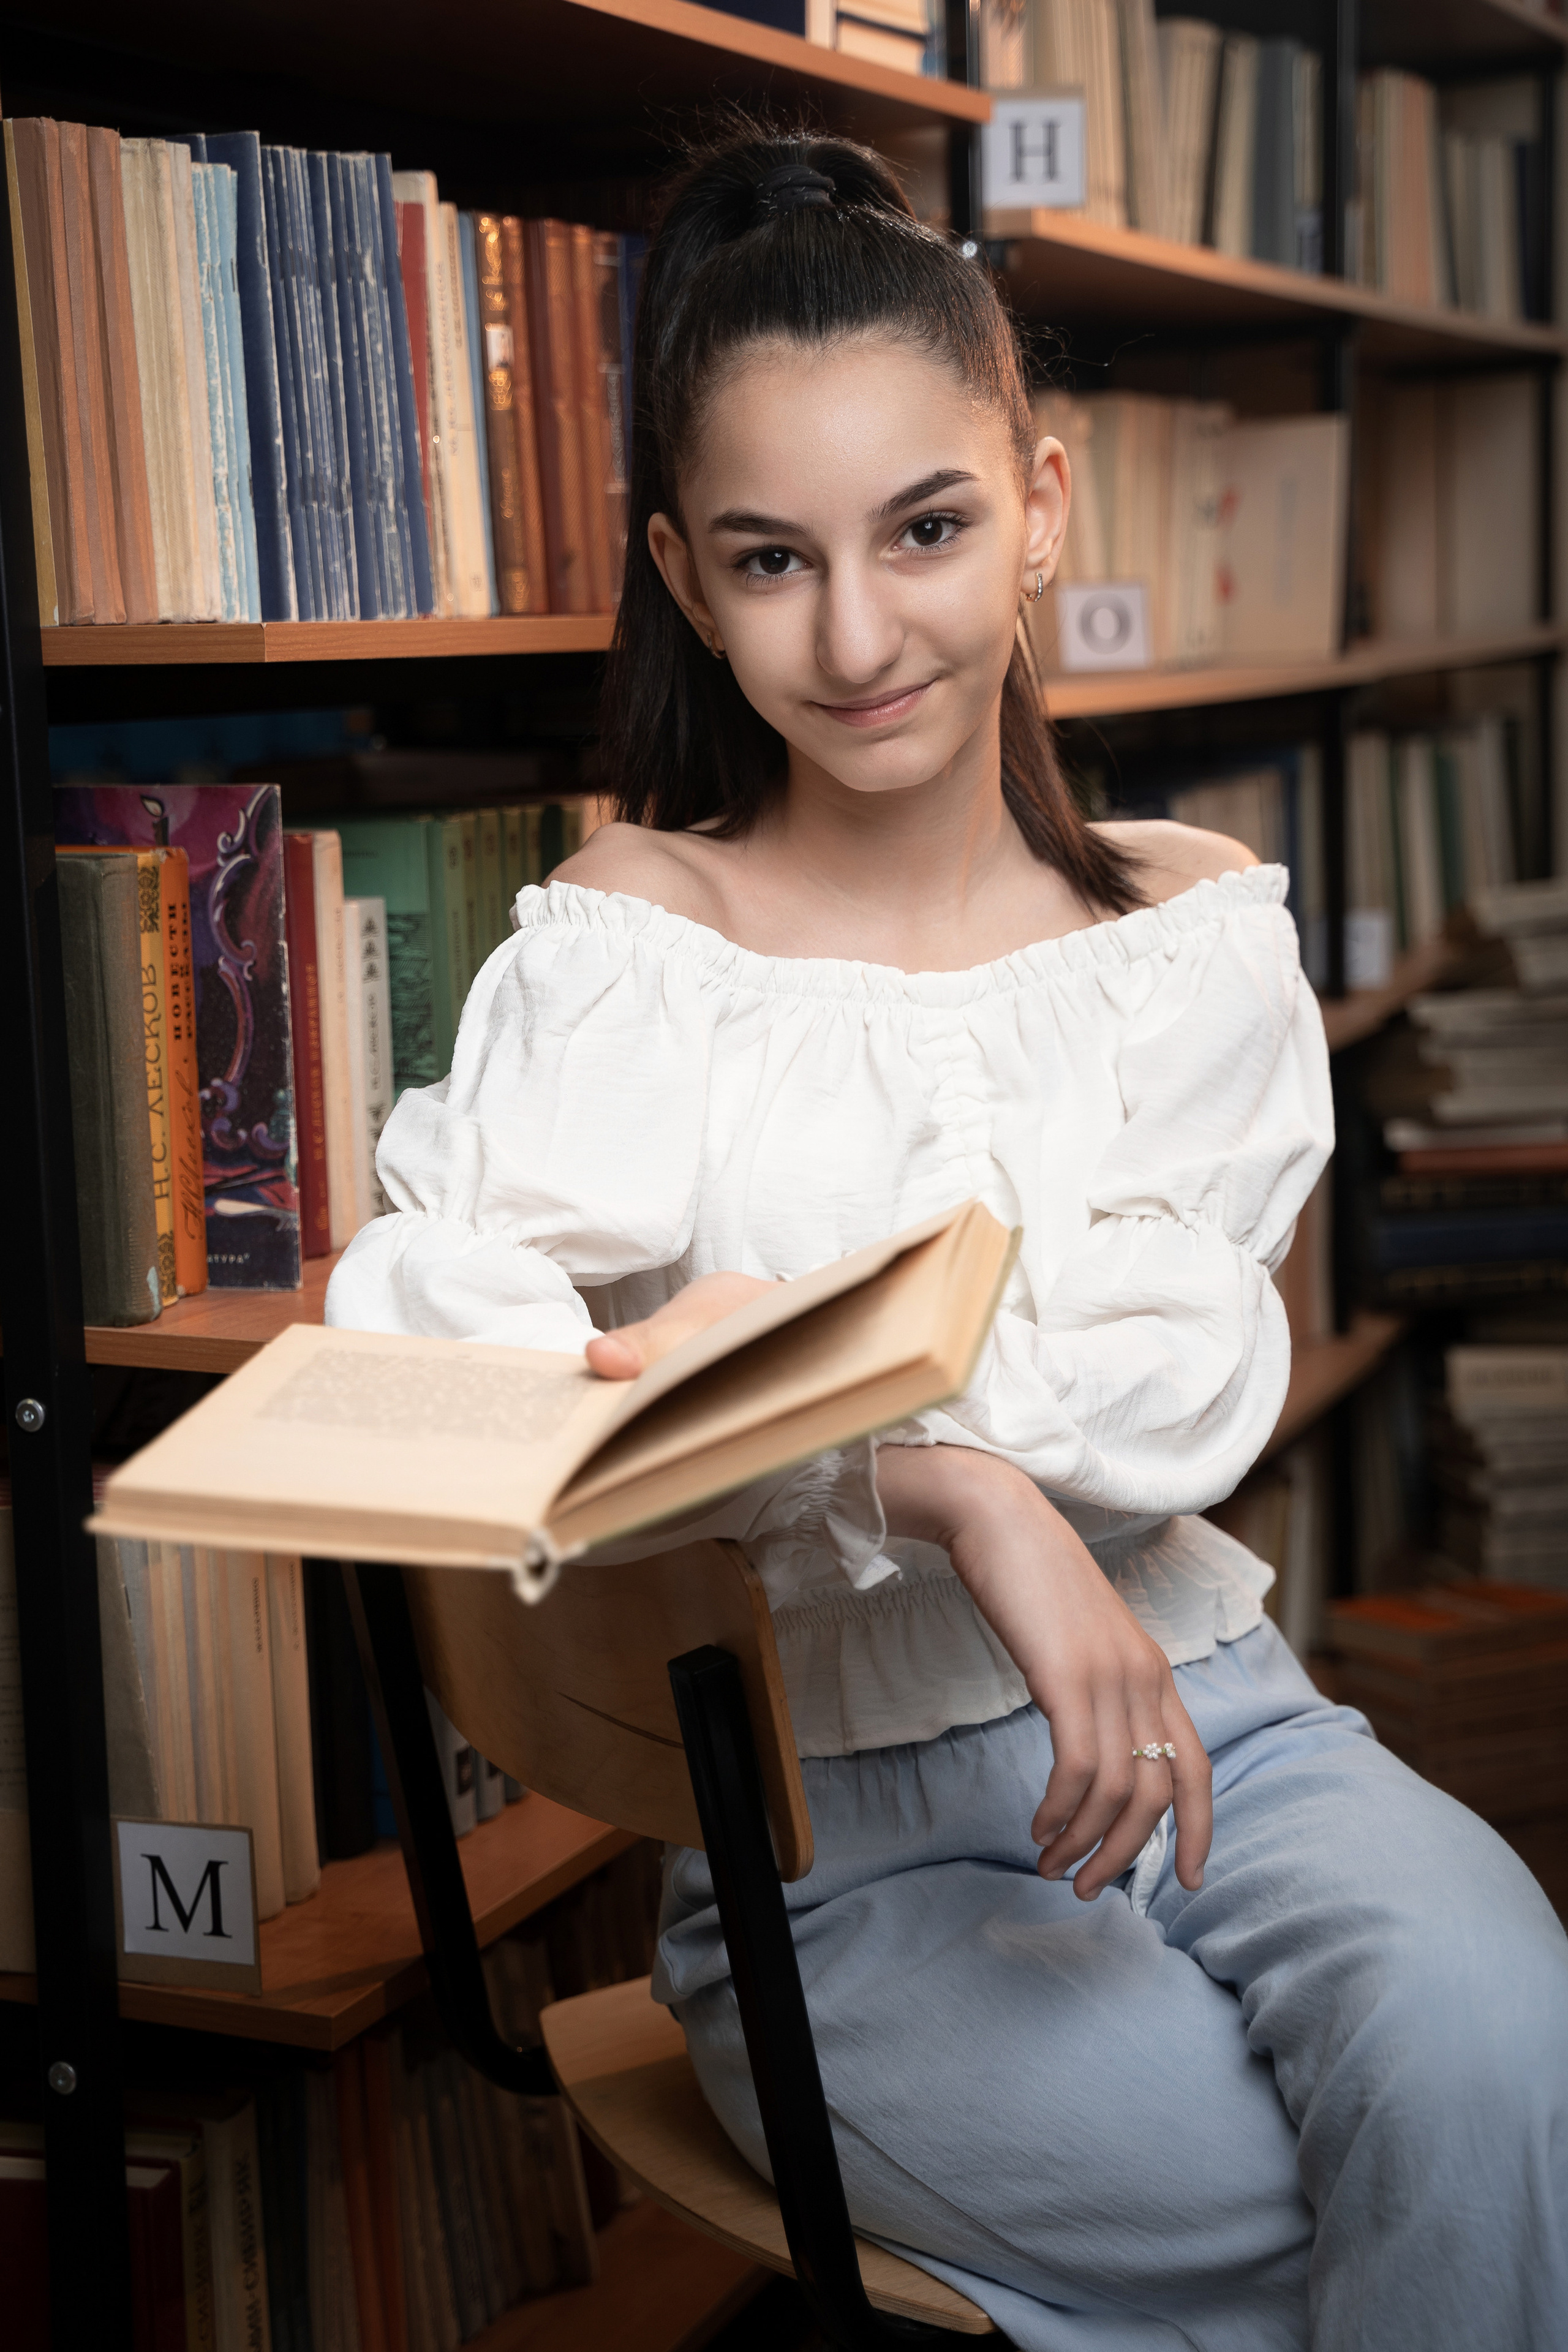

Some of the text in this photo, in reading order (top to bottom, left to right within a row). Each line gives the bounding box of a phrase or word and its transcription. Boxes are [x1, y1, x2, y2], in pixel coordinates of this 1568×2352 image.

[1008, 118, 1061, 184] Н
[1077, 592, 1132, 655] О
[168, 903, 182, 1041] ПОВЕСТИ
[141, 964, 164, 1117] ЛЕСКОВ
[140, 1853, 233, 1940] М
[235, 2151, 263, 2352] МИН-СИБИРЯК
